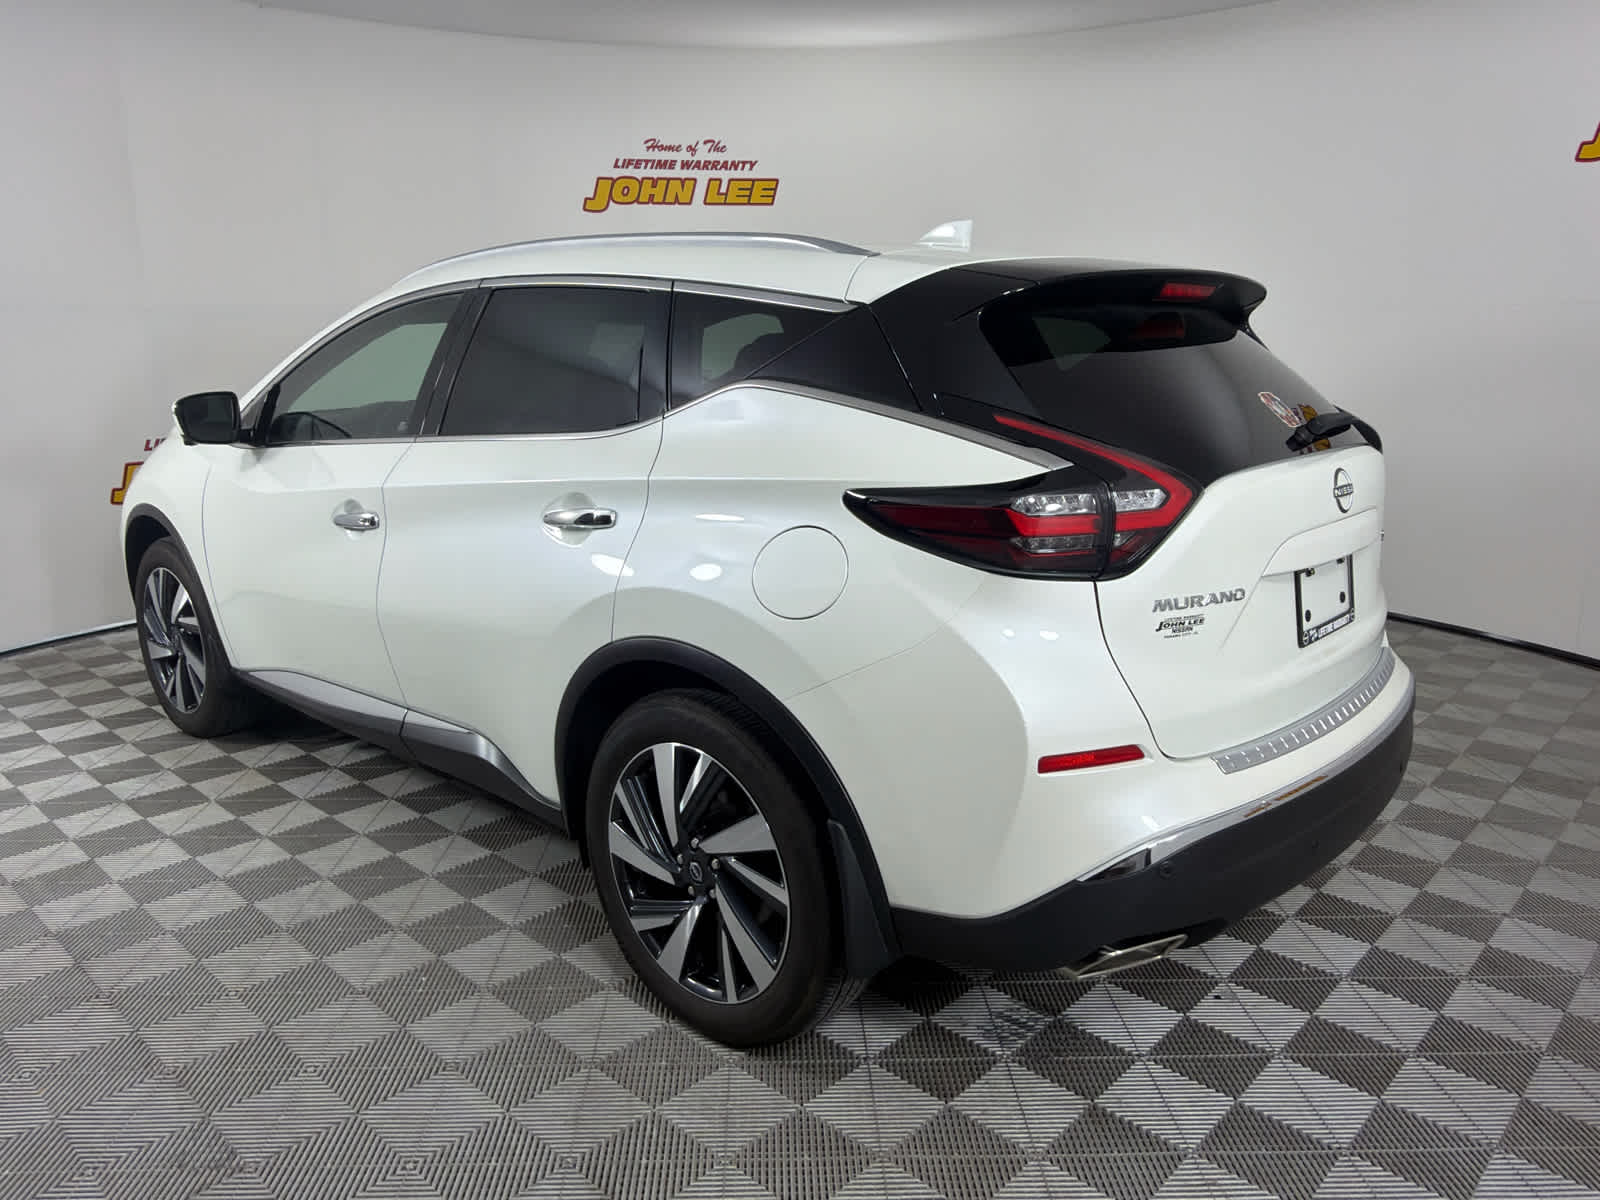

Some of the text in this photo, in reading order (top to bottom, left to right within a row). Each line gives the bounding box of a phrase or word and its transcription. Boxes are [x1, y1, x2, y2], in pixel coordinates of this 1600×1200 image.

[643, 138, 728, 156] Home of The
[613, 158, 758, 171] LIFETIME WARRANTY
[583, 176, 779, 213] JOHN LEE
[1152, 588, 1246, 612] MURANO
[1155, 621, 1186, 632] JOHN
